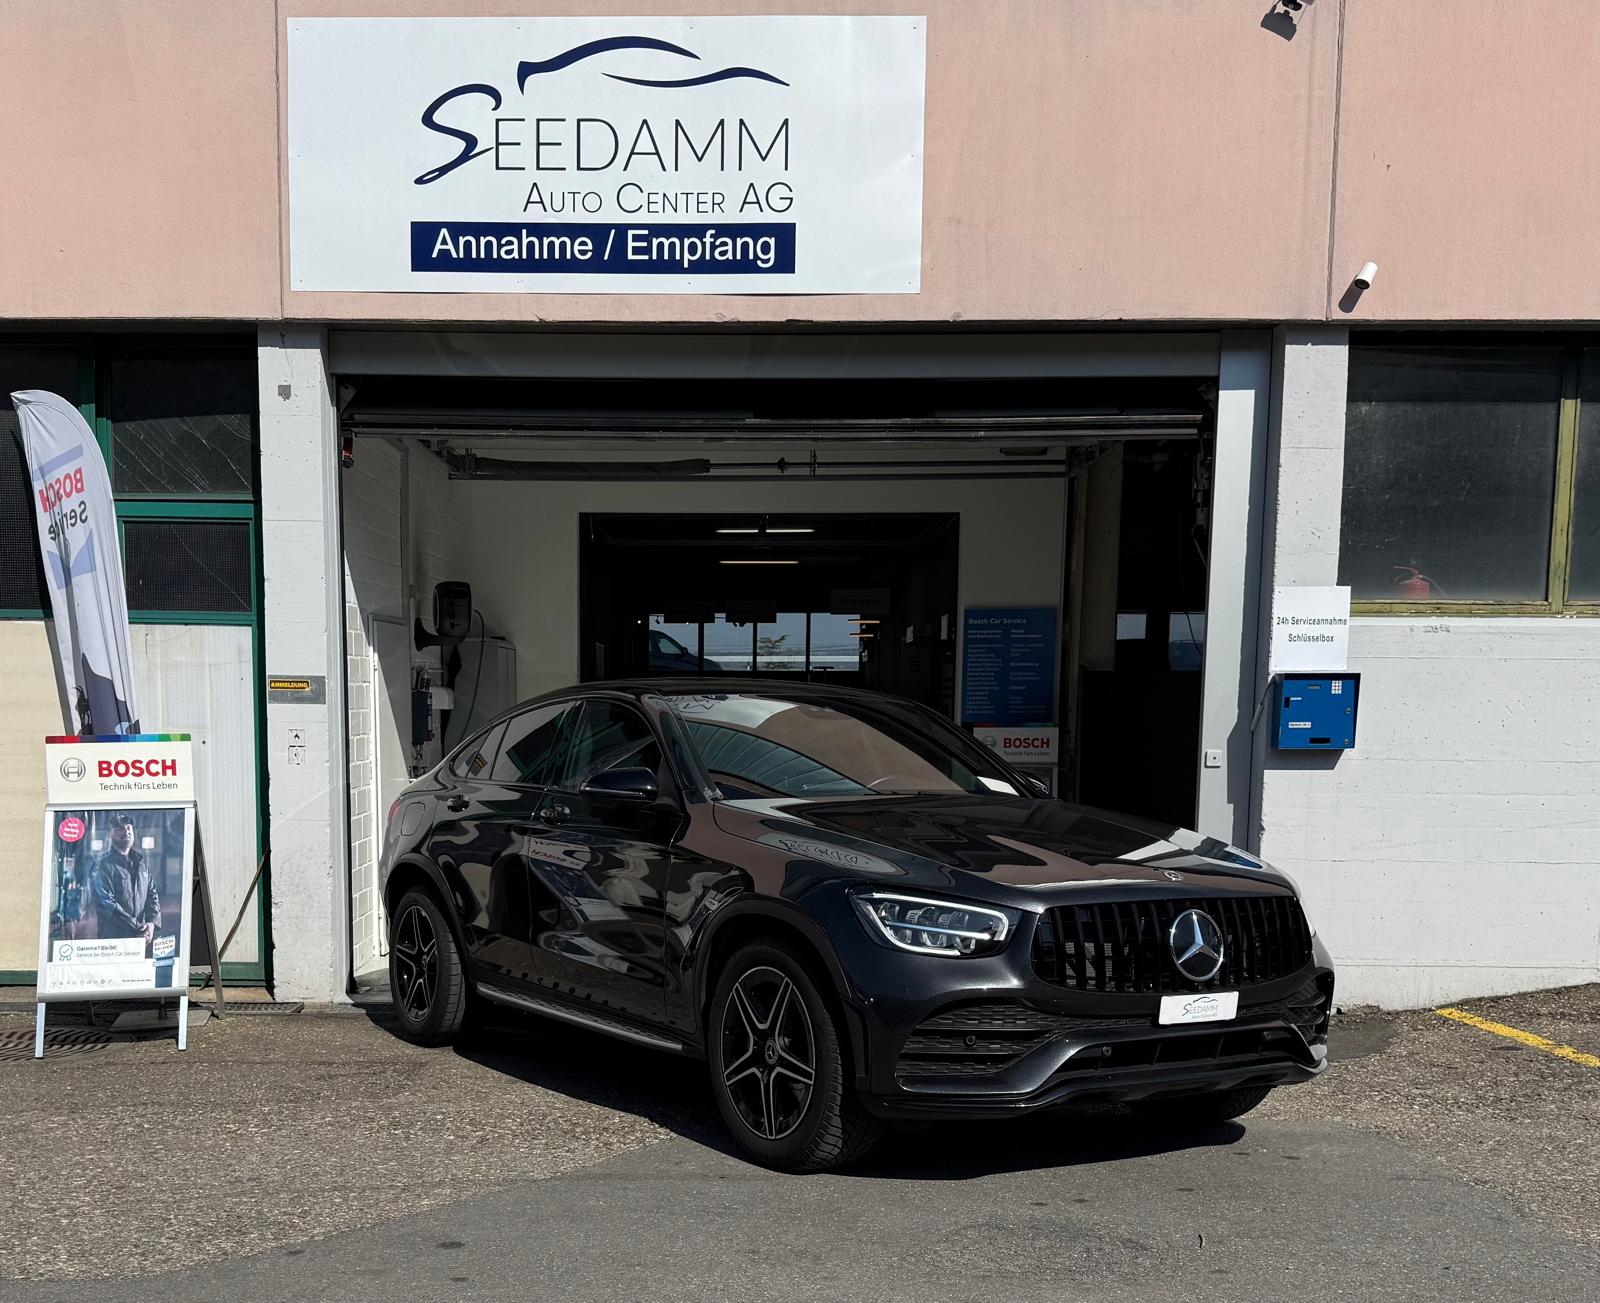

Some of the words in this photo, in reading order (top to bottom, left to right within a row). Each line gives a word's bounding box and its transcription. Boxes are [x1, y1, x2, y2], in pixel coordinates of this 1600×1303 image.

[413, 83, 790, 185] SEEDAMM
[739, 182, 794, 214] AG
[432, 229, 593, 260] Annahme
[604, 230, 613, 261] /
[627, 230, 776, 268] Empfang
[989, 617, 1002, 625] Car
[1003, 617, 1027, 625] Service
[1276, 616, 1290, 625] 24h
[1291, 616, 1348, 626] Serviceannahme
[1287, 633, 1335, 643] Schlüsselbox
[1003, 738, 1050, 748] BOSCH
[97, 759, 177, 778] BOSCH
[99, 782, 133, 791] Technik
[133, 782, 150, 790] fürs
[152, 781, 178, 790] Leben
